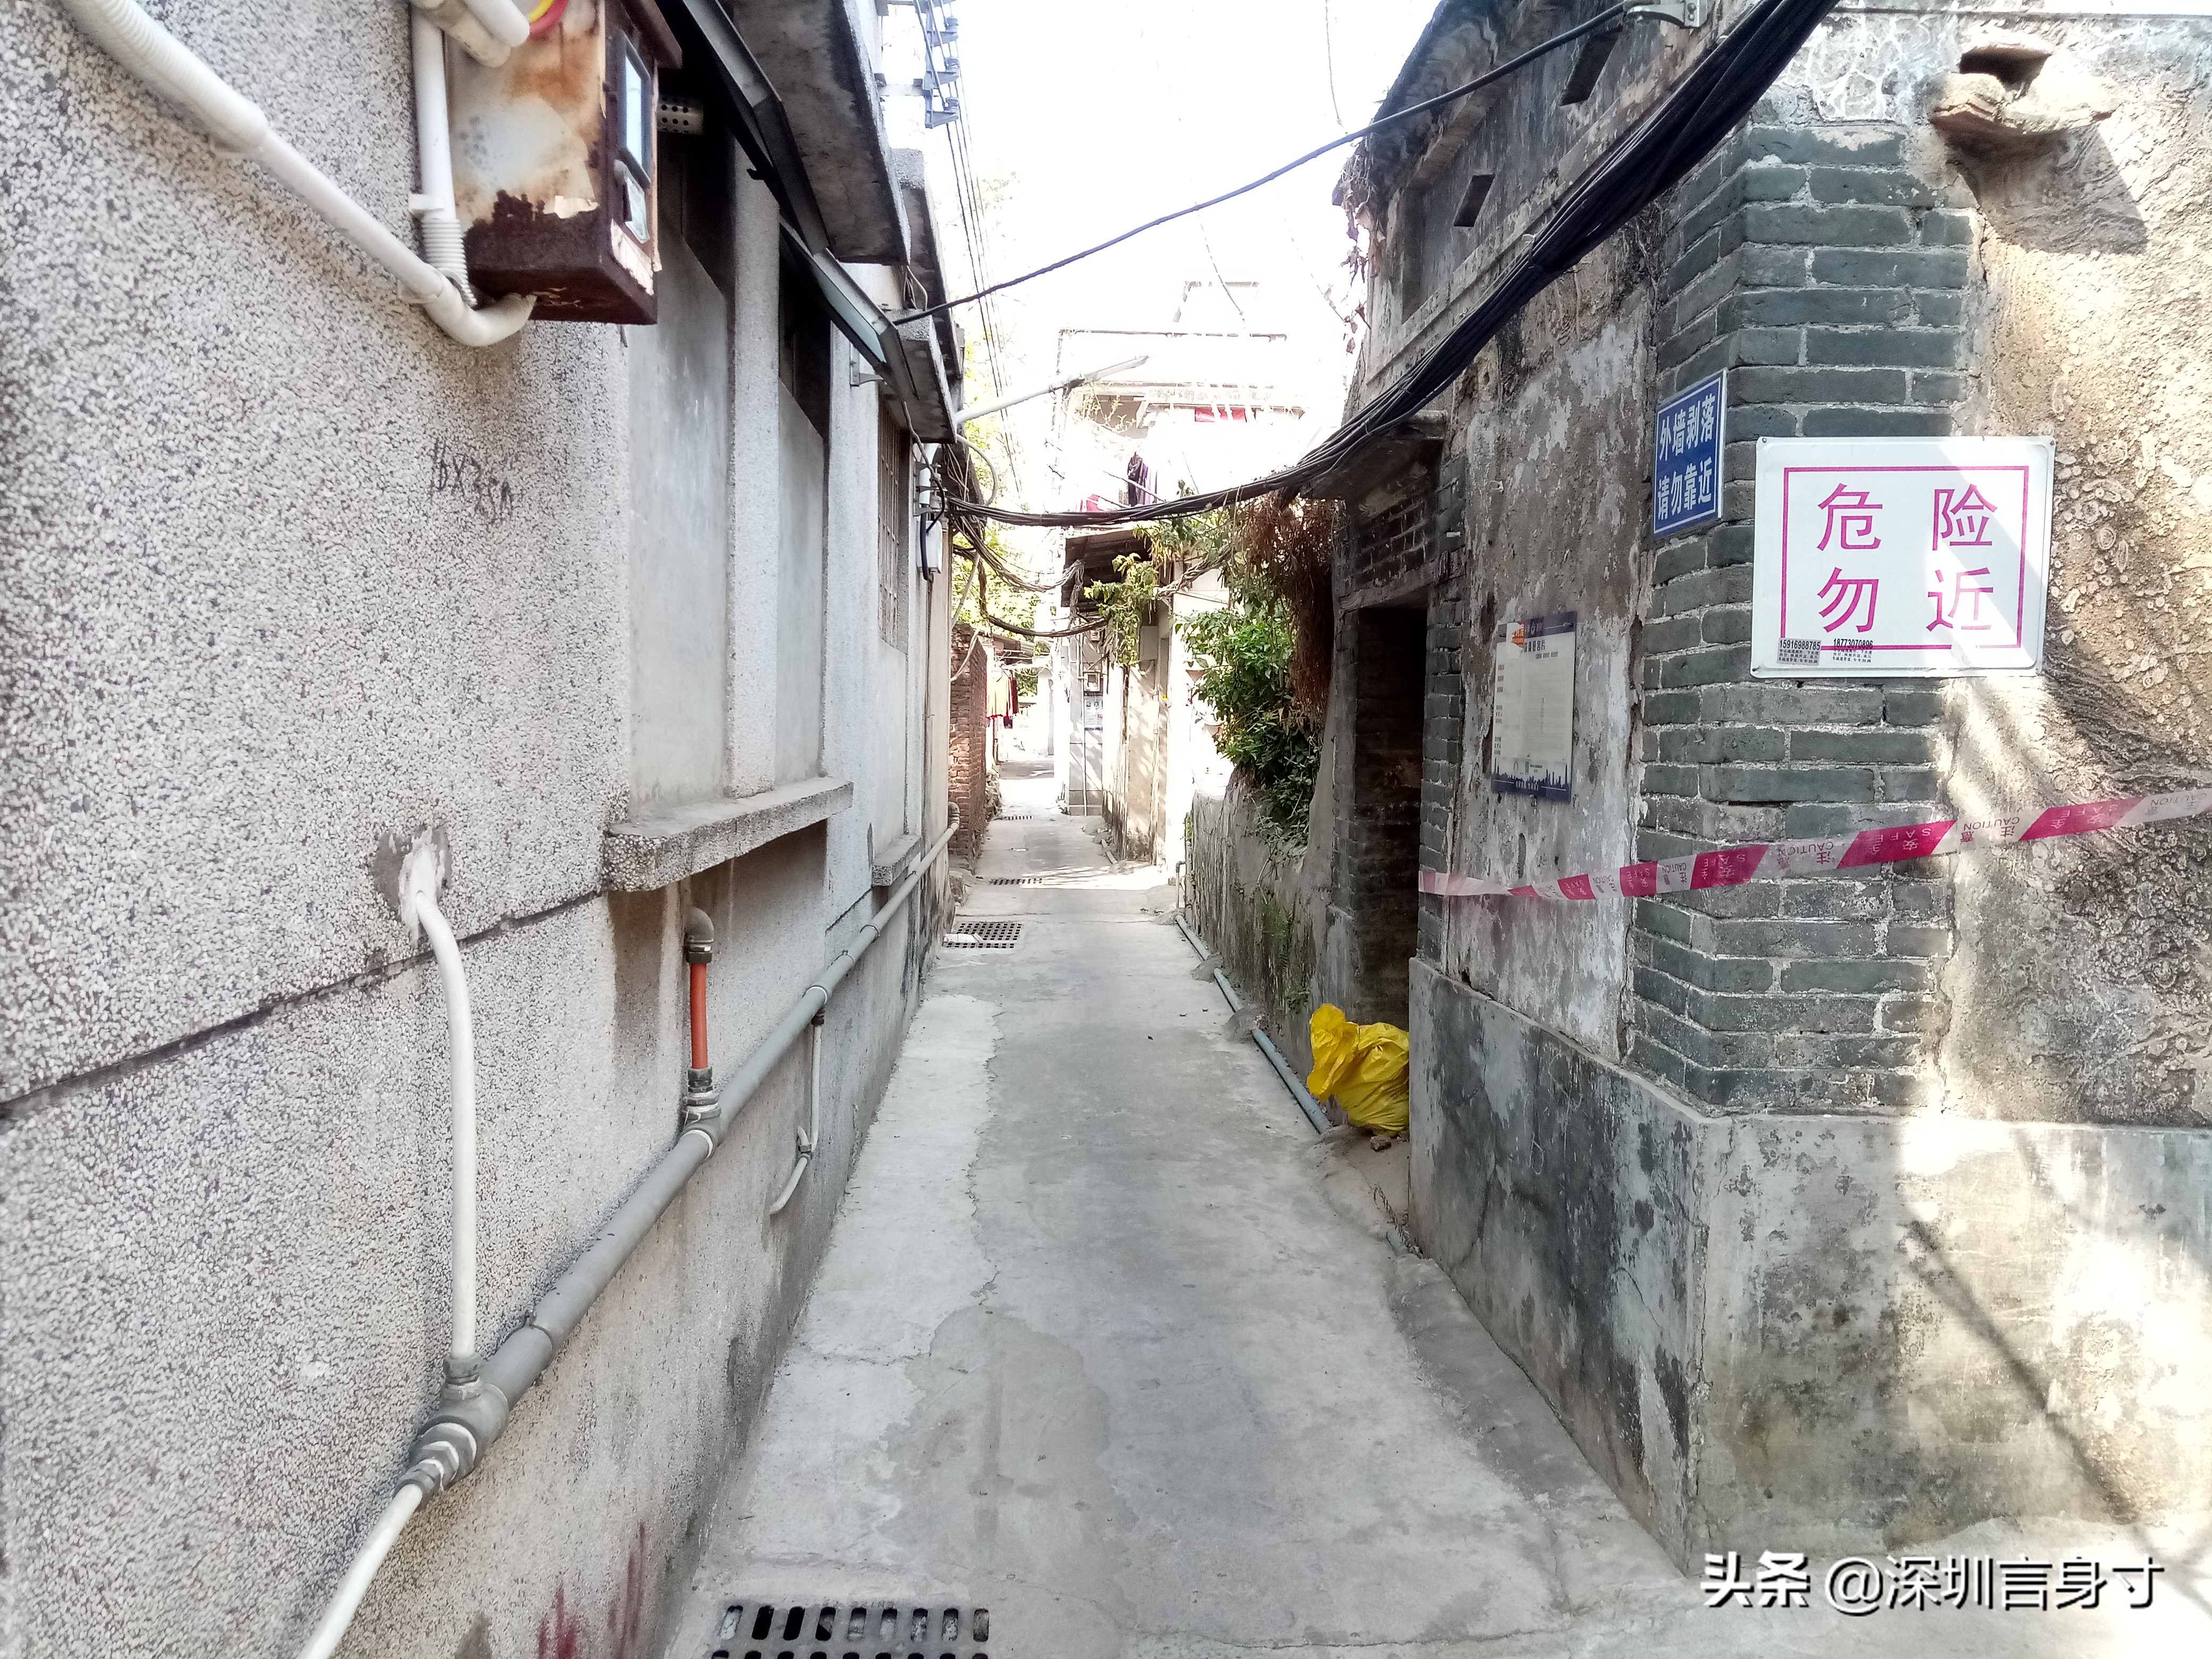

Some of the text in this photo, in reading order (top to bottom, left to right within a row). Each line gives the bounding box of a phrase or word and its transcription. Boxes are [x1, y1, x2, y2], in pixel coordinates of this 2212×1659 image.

[1659, 393, 1716, 462] 外墙剥落
[1657, 457, 1712, 521] 请勿靠近
[1817, 482, 1998, 551] 危险
[1816, 566, 1993, 633] 勿近
[1780, 639, 1821, 650] 15916988785
[1833, 638, 1873, 649] 18773070896
[2063, 804, 2118, 817] SAFE
[1963, 816, 2020, 831] CAUTION
[1872, 827, 1931, 841] SAFE
[1961, 825, 2017, 843] 注意
[1778, 842, 1833, 856] CAUTION
[1869, 839, 1920, 854] 安全
[1627, 868, 1650, 878] SAFE
[1662, 862, 1687, 873] CAUTION
[1593, 875, 1613, 884] CAUTION
